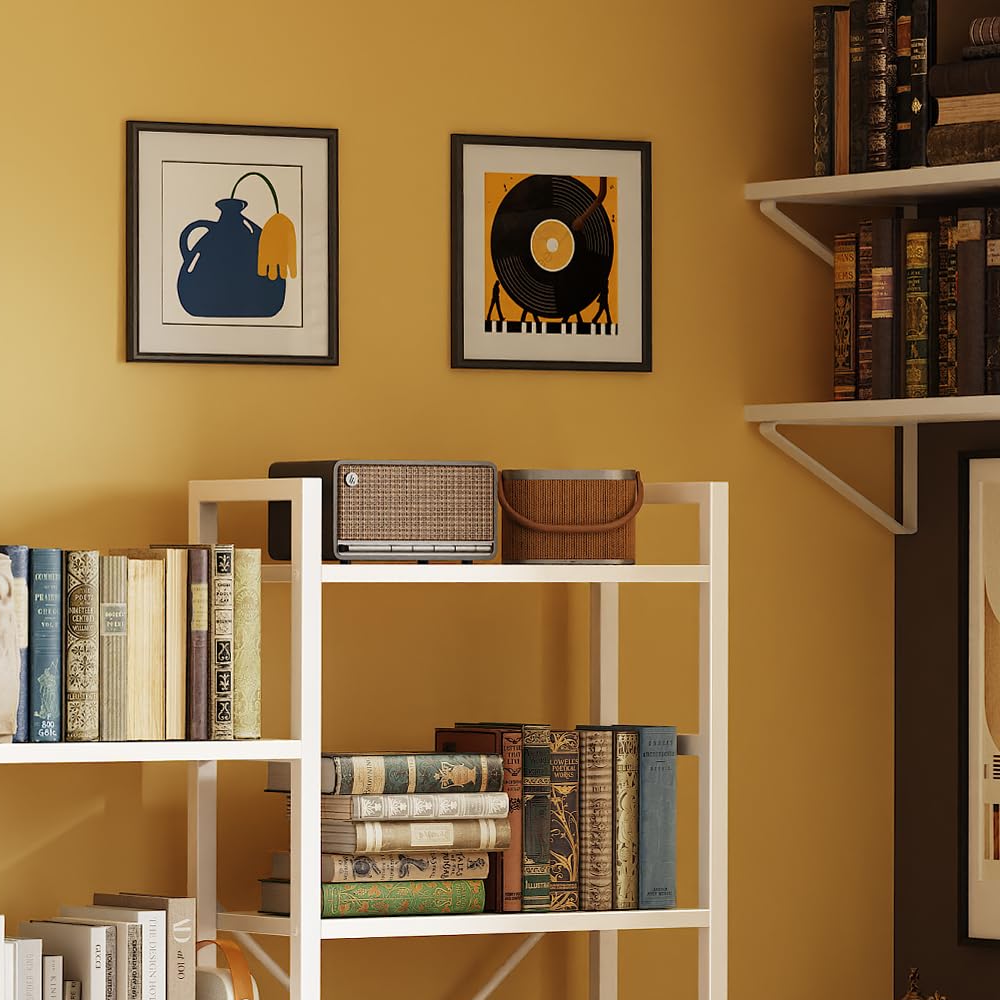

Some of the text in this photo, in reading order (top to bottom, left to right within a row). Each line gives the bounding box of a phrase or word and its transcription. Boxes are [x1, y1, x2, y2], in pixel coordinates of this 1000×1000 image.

[148, 919, 157, 939] THE
[148, 942, 157, 978] DESIGN
[176, 950, 185, 960] at
[176, 962, 185, 980] 100
